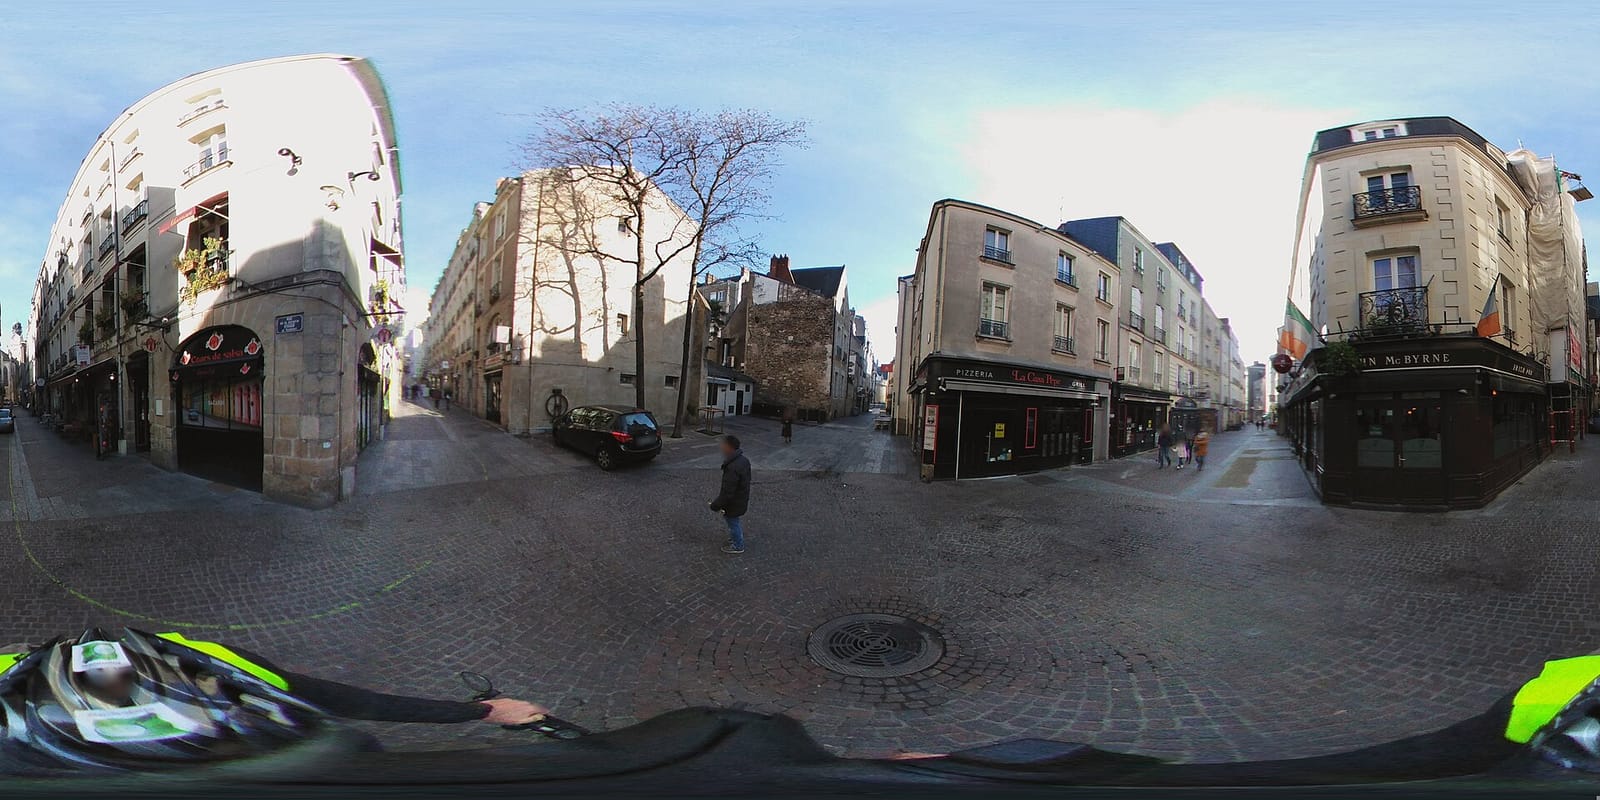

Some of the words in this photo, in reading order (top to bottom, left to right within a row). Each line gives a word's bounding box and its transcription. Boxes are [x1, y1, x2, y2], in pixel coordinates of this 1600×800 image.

[224, 349, 243, 358] salsa
[956, 369, 993, 378] PIZZERIA
[1011, 369, 1026, 382] La
